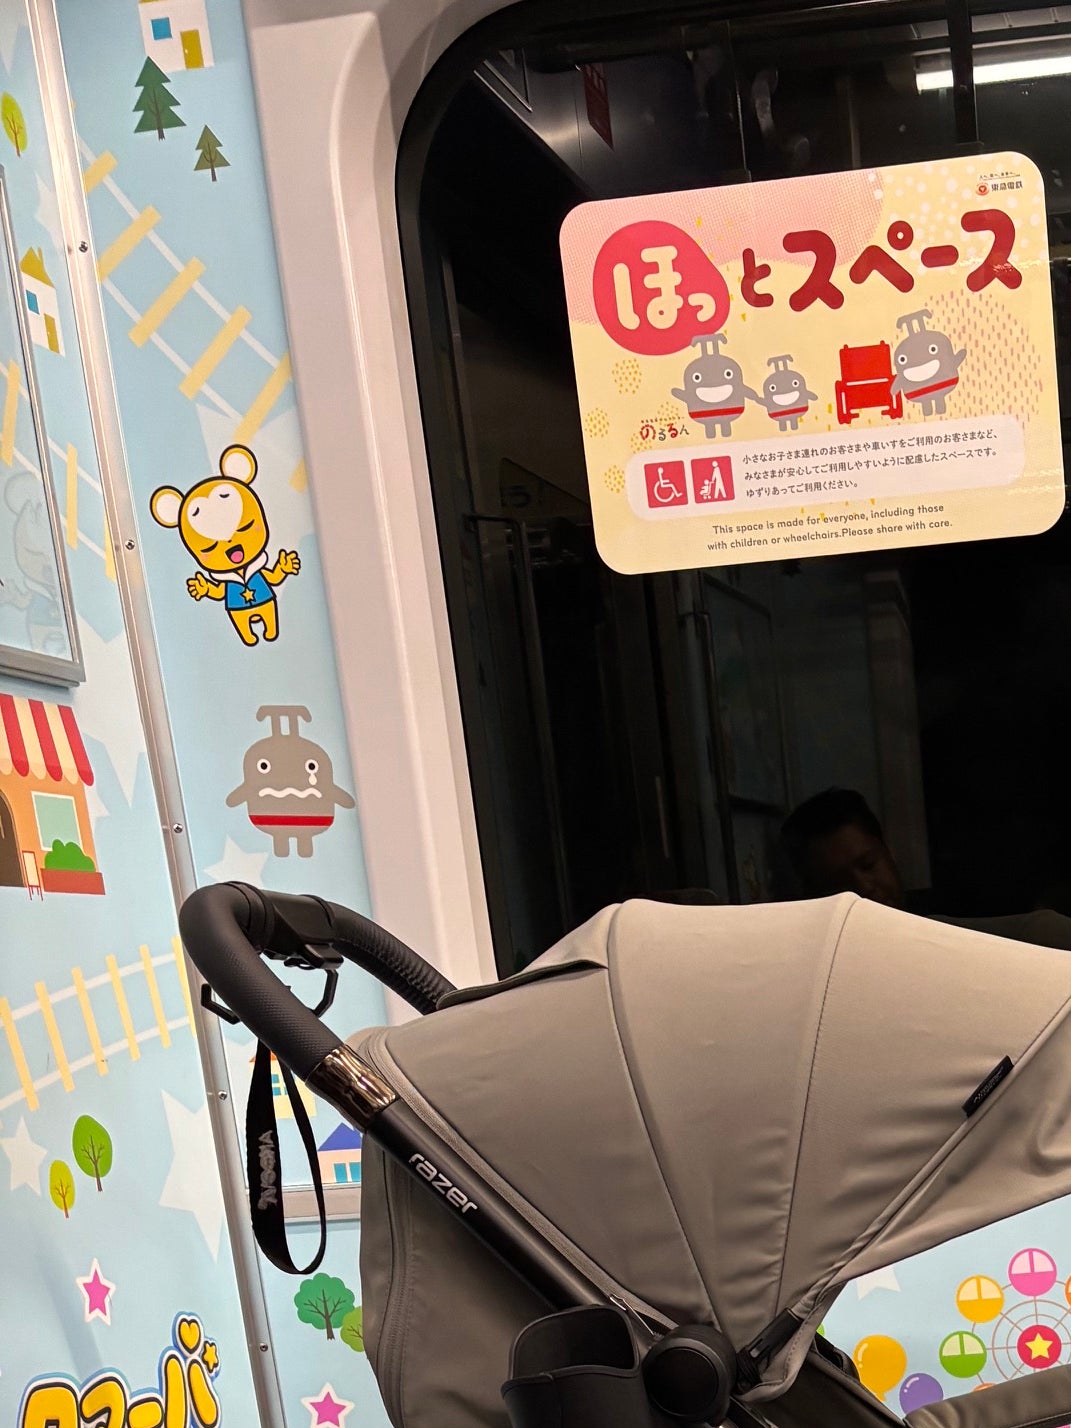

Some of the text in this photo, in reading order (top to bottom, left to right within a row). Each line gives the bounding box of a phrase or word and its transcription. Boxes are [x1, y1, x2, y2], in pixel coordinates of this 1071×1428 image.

[611, 208, 1023, 330] ほっとスペース
[640, 423, 690, 441] のるるん
[742, 429, 998, 465] 小さなお子さま連れのお客さまや車いすをご利用のお客さまなど、
[744, 447, 997, 481] みなさまが安心してご利用しやすいように配慮したスペースです。
[746, 479, 858, 497] ゆずりあってご利用ください。
[707, 540, 728, 550] with
[730, 537, 768, 548] children
[771, 536, 781, 544] or
[876, 523, 903, 533] share
[905, 520, 926, 530] with
[928, 519, 953, 528] care.
[712, 503, 945, 534] This space is made for everyone, including those
[408, 1153, 478, 1213] razer
